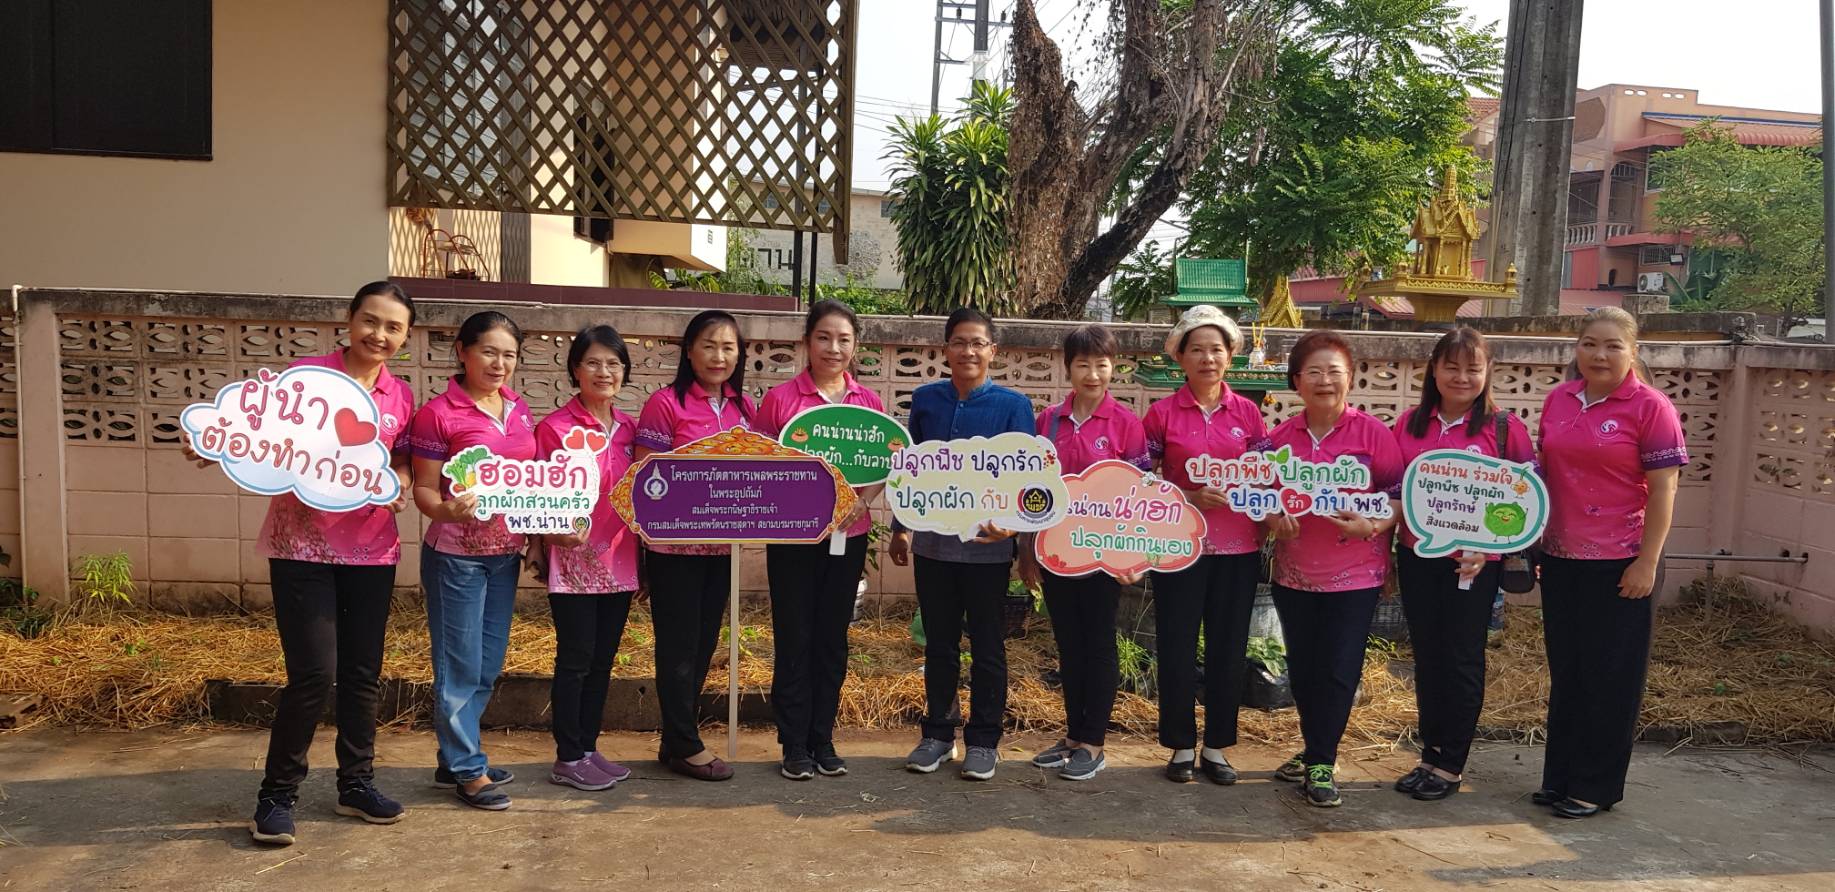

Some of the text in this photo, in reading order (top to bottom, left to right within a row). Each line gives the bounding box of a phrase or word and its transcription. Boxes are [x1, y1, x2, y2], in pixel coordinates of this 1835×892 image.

[240, 369, 329, 431] ผู้นำ
[812, 422, 885, 443] คนน่านน่าฮัก
[202, 417, 383, 495] ต้องทำก่อน
[893, 448, 1042, 478] ปลูกพืช ปลูกรัก
[479, 454, 588, 489] ฮอมฮัก
[1190, 455, 1366, 490] ปลูกพืช ปลูกผัก
[1419, 461, 1513, 485] คนน่าน ร่วมใจ
[476, 489, 590, 515] ลูกผักสวนครัว
[708, 484, 762, 502] ในพระอุปถัมภ์
[896, 485, 1009, 516] ปลูกผัก กับ
[1231, 488, 1389, 516] ปลูก รัก กับ พช.
[1418, 477, 1505, 500] ปลูกพืช ปลูกผัก
[1427, 498, 1476, 514] ปลูกรักษ์
[508, 512, 569, 529] พช.น่าน
[1425, 513, 1479, 533] สิ่งแวดล้อม
[1071, 524, 1193, 559] ปลูกผักกินเอง
